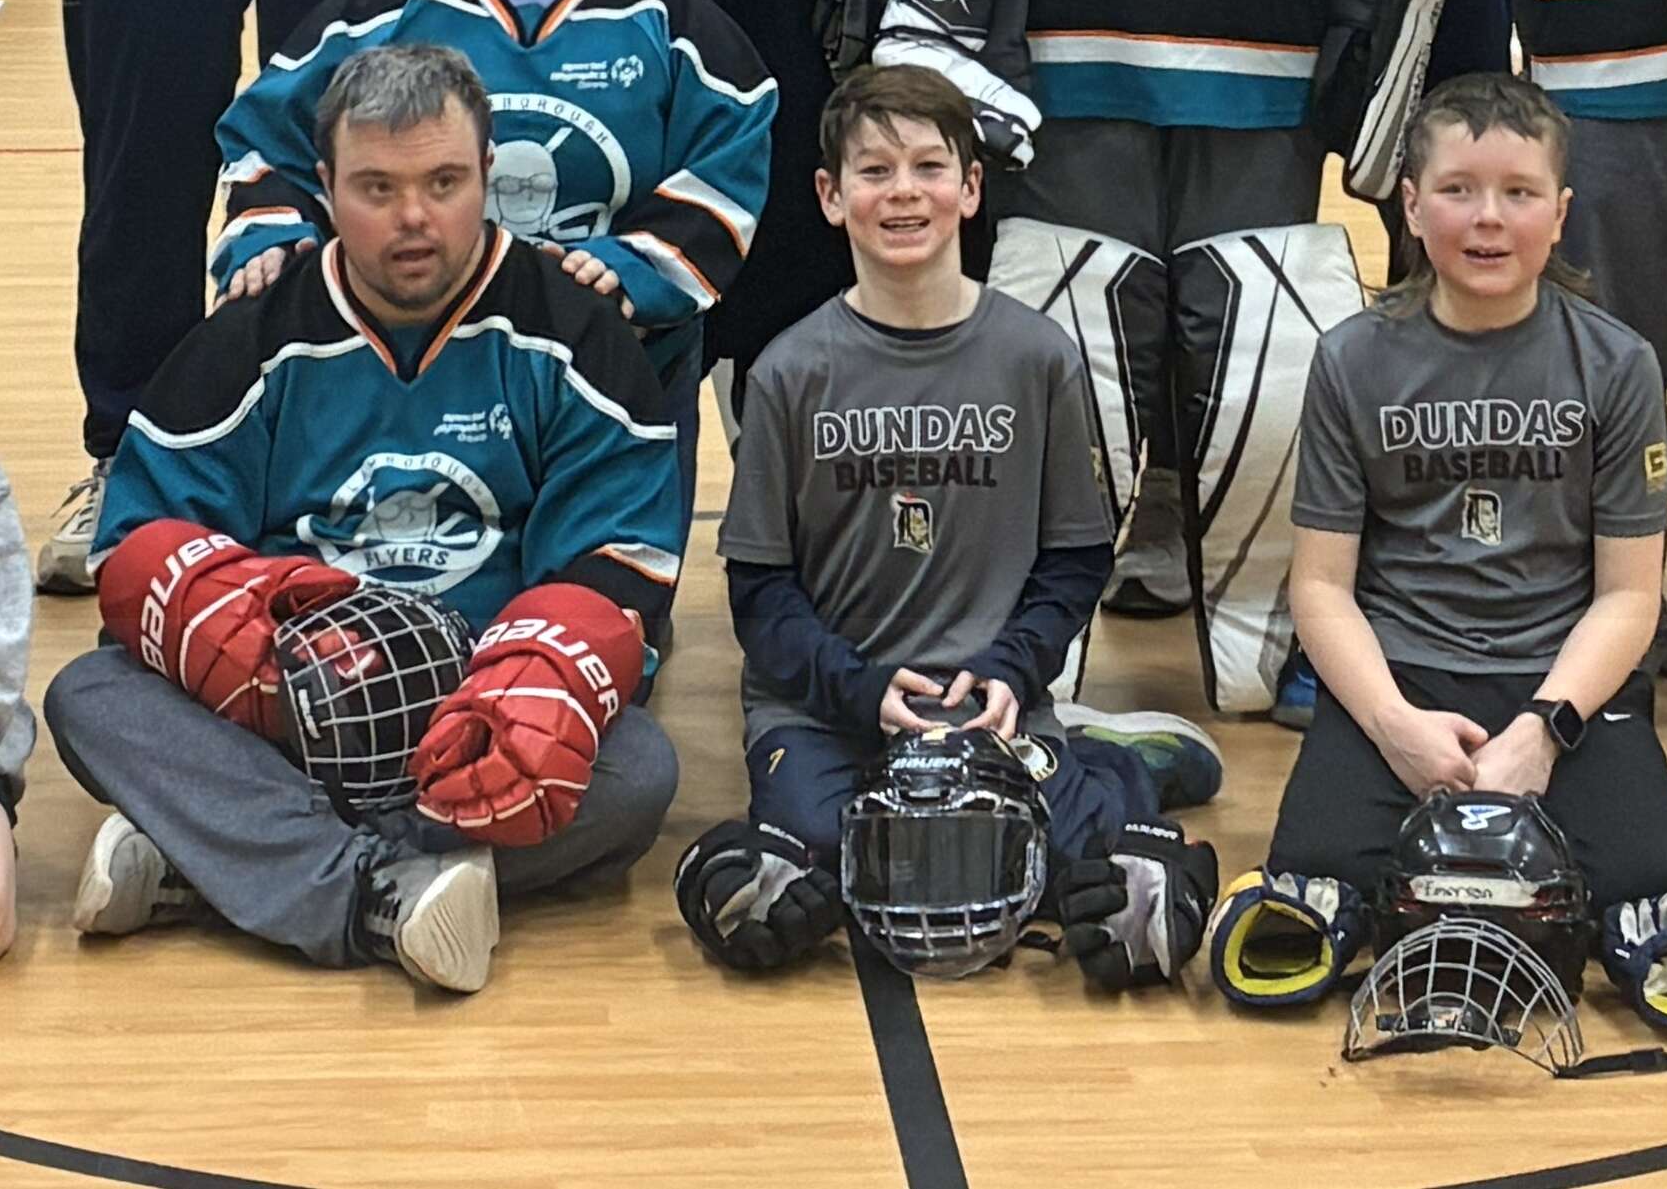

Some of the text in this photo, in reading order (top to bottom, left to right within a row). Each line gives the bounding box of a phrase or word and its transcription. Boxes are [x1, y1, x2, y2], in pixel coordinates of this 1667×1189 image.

[502, 96, 610, 144] BOROUGH
[814, 404, 1016, 459] DUNDAS
[1379, 399, 1587, 453] DUNDAS
[835, 455, 998, 491] BASEBALL
[1403, 449, 1565, 483] BASEBALL
[363, 546, 450, 568] FLYERS
